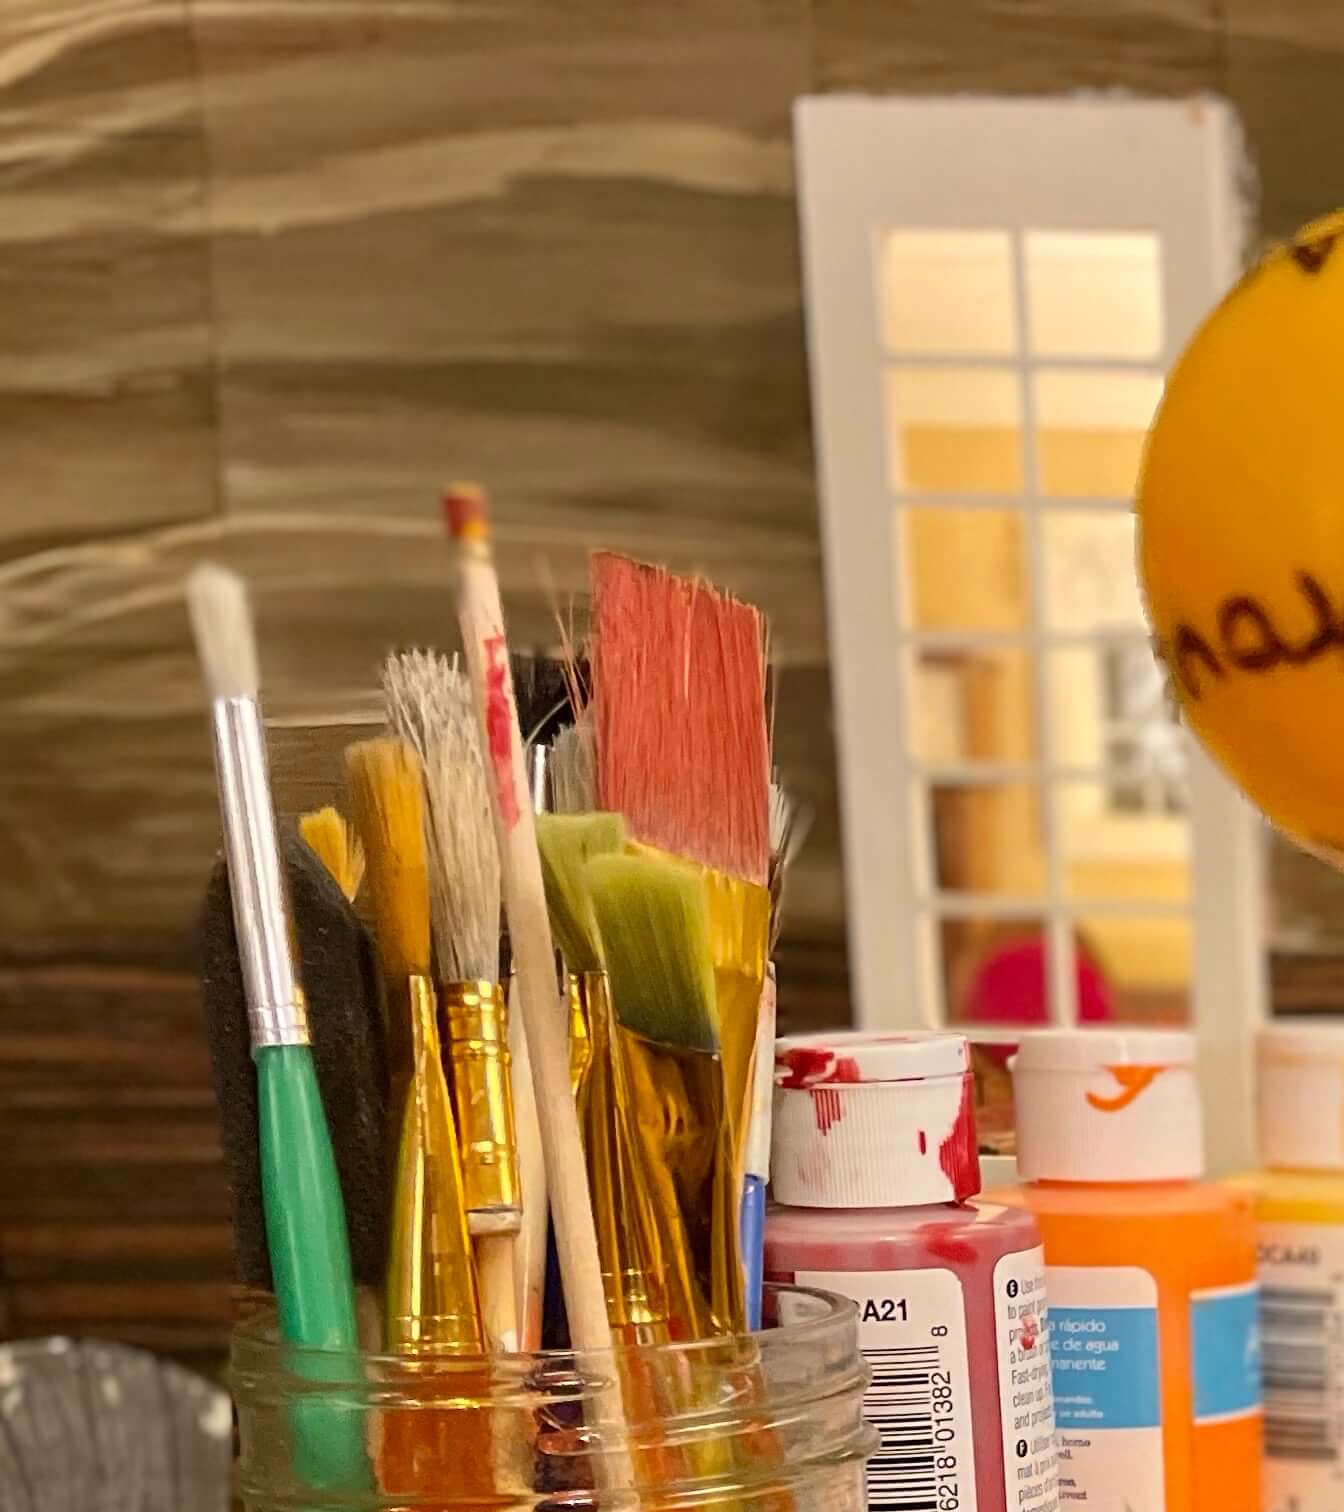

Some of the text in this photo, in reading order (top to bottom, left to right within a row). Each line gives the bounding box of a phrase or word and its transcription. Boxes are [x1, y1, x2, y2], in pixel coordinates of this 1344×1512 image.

[856, 1298, 908, 1322] A21
[931, 1325, 948, 1337] 8
[931, 1371, 954, 1442] 01382
[1015, 1412, 1030, 1430] and
